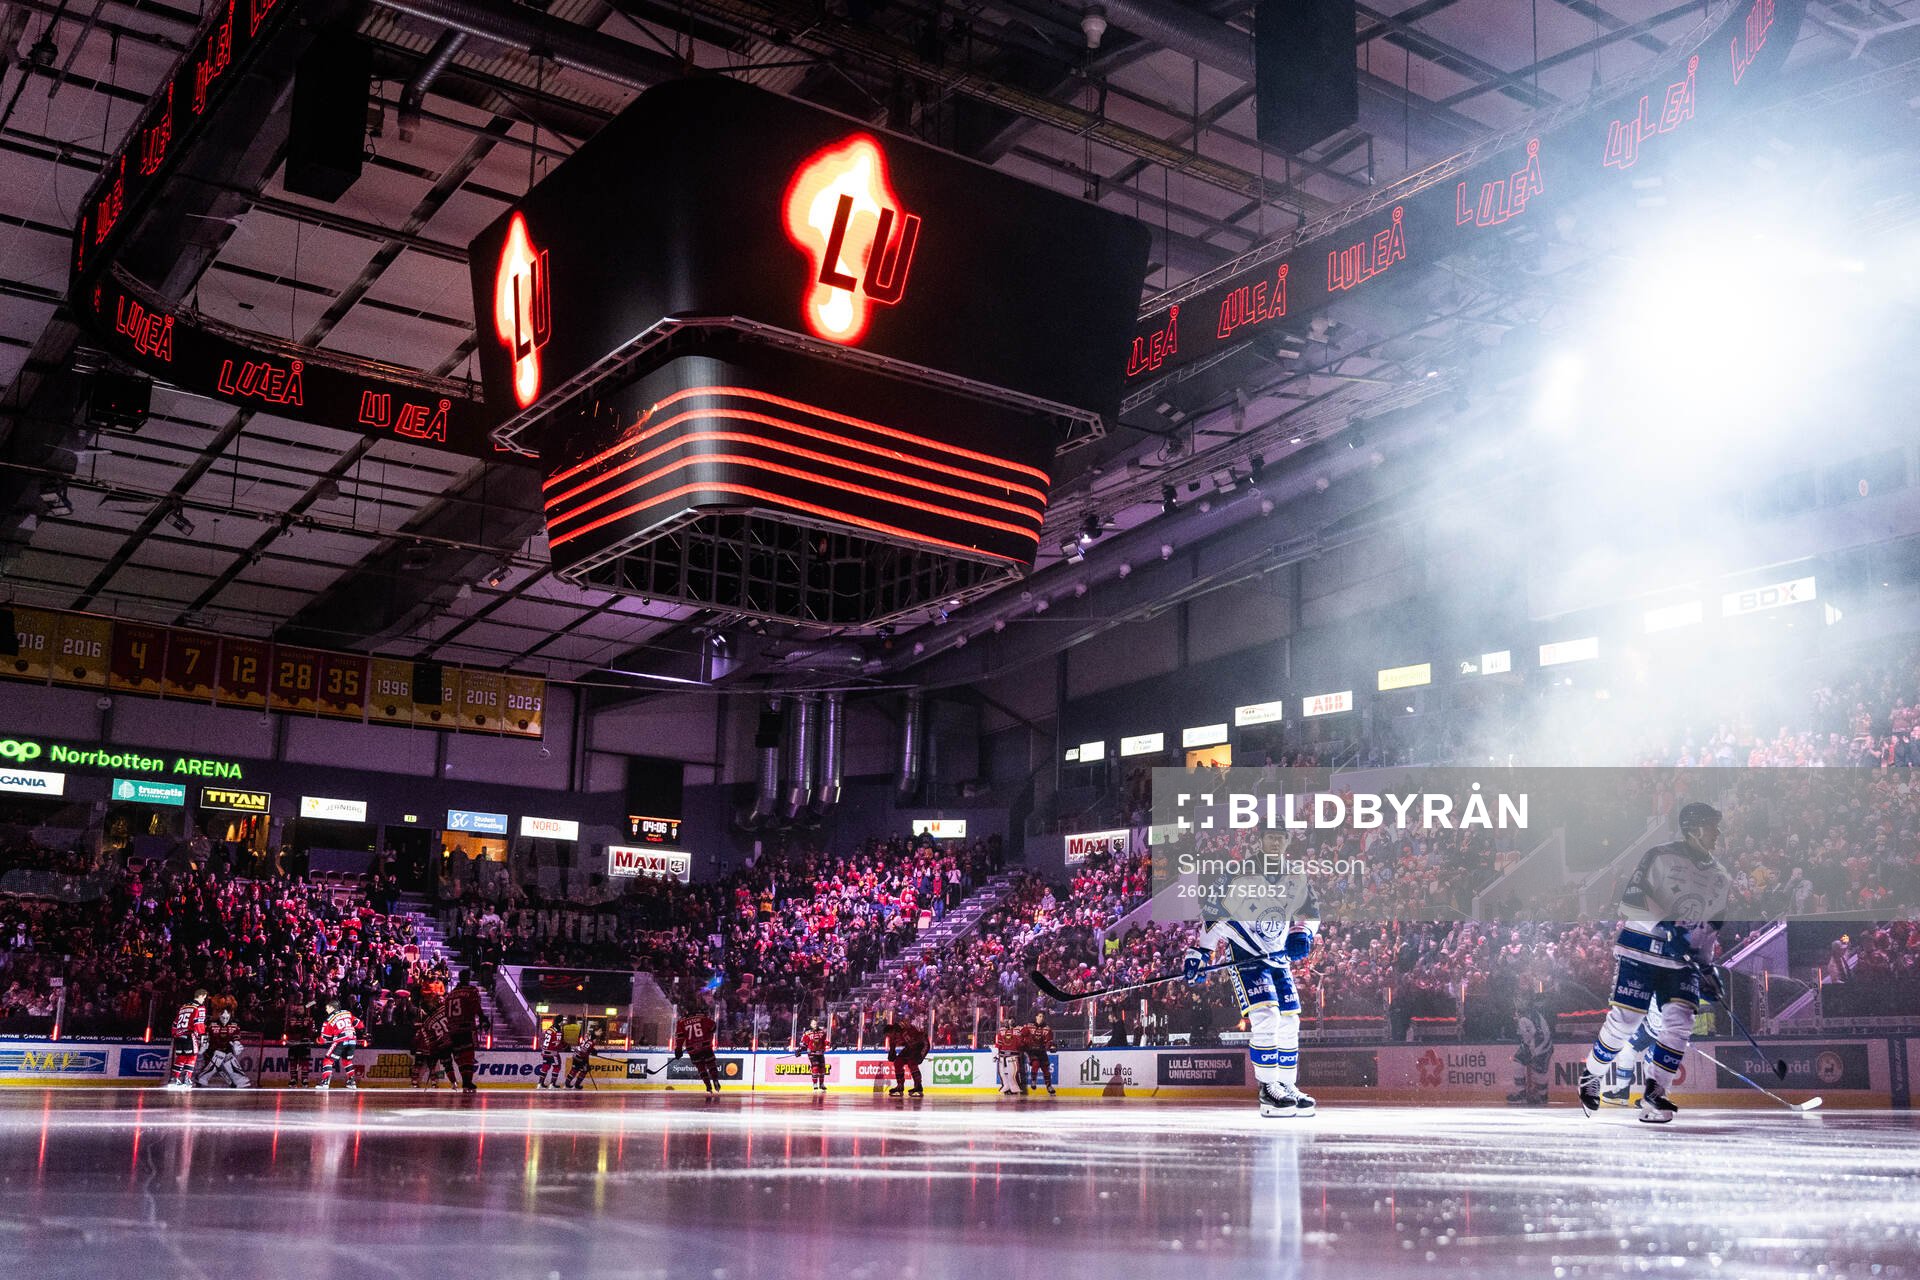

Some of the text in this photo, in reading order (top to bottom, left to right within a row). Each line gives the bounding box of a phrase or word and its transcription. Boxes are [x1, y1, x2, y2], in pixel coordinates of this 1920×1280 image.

[818, 193, 921, 305] LU
[1328, 207, 1406, 292] LULEÅ
[1216, 263, 1289, 339] LULEÅ
[117, 295, 173, 362] LULEÅ
[217, 360, 304, 406] LULEÅ
[63, 638, 102, 658] 2016
[131, 641, 148, 669] 4
[185, 647, 201, 675] 7
[232, 654, 258, 683] 12
[279, 662, 313, 691] 28
[327, 668, 359, 696] 35
[376, 679, 409, 697] 1996
[466, 689, 497, 707] 2015
[508, 693, 541, 712] 2025
[1312, 694, 1344, 714] ABB
[50, 745, 165, 773] Norrbotten
[172, 758, 243, 780] ARENA
[0, 775, 47, 788] CANIA
[206, 789, 267, 805] TITAN
[642, 820, 668, 834] 04:06
[1069, 838, 1110, 855] MAXI
[615, 851, 667, 871] MAXI
[176, 1012, 191, 1029] 25
[684, 1022, 703, 1040] 76
[933, 1058, 973, 1077] coop
[1168, 1057, 1233, 1070] LULEÅ TEKNISKA
[1447, 1052, 1487, 1067] Luleå
[1744, 1060, 1811, 1074] Polaröd
[628, 1063, 648, 1075] CAT
[774, 1063, 832, 1076] SPORTBLT
[1102, 1067, 1133, 1076] ALLBYGG
[1168, 1069, 1218, 1080] UNIVERSITET
[1448, 1070, 1496, 1086] Energi
